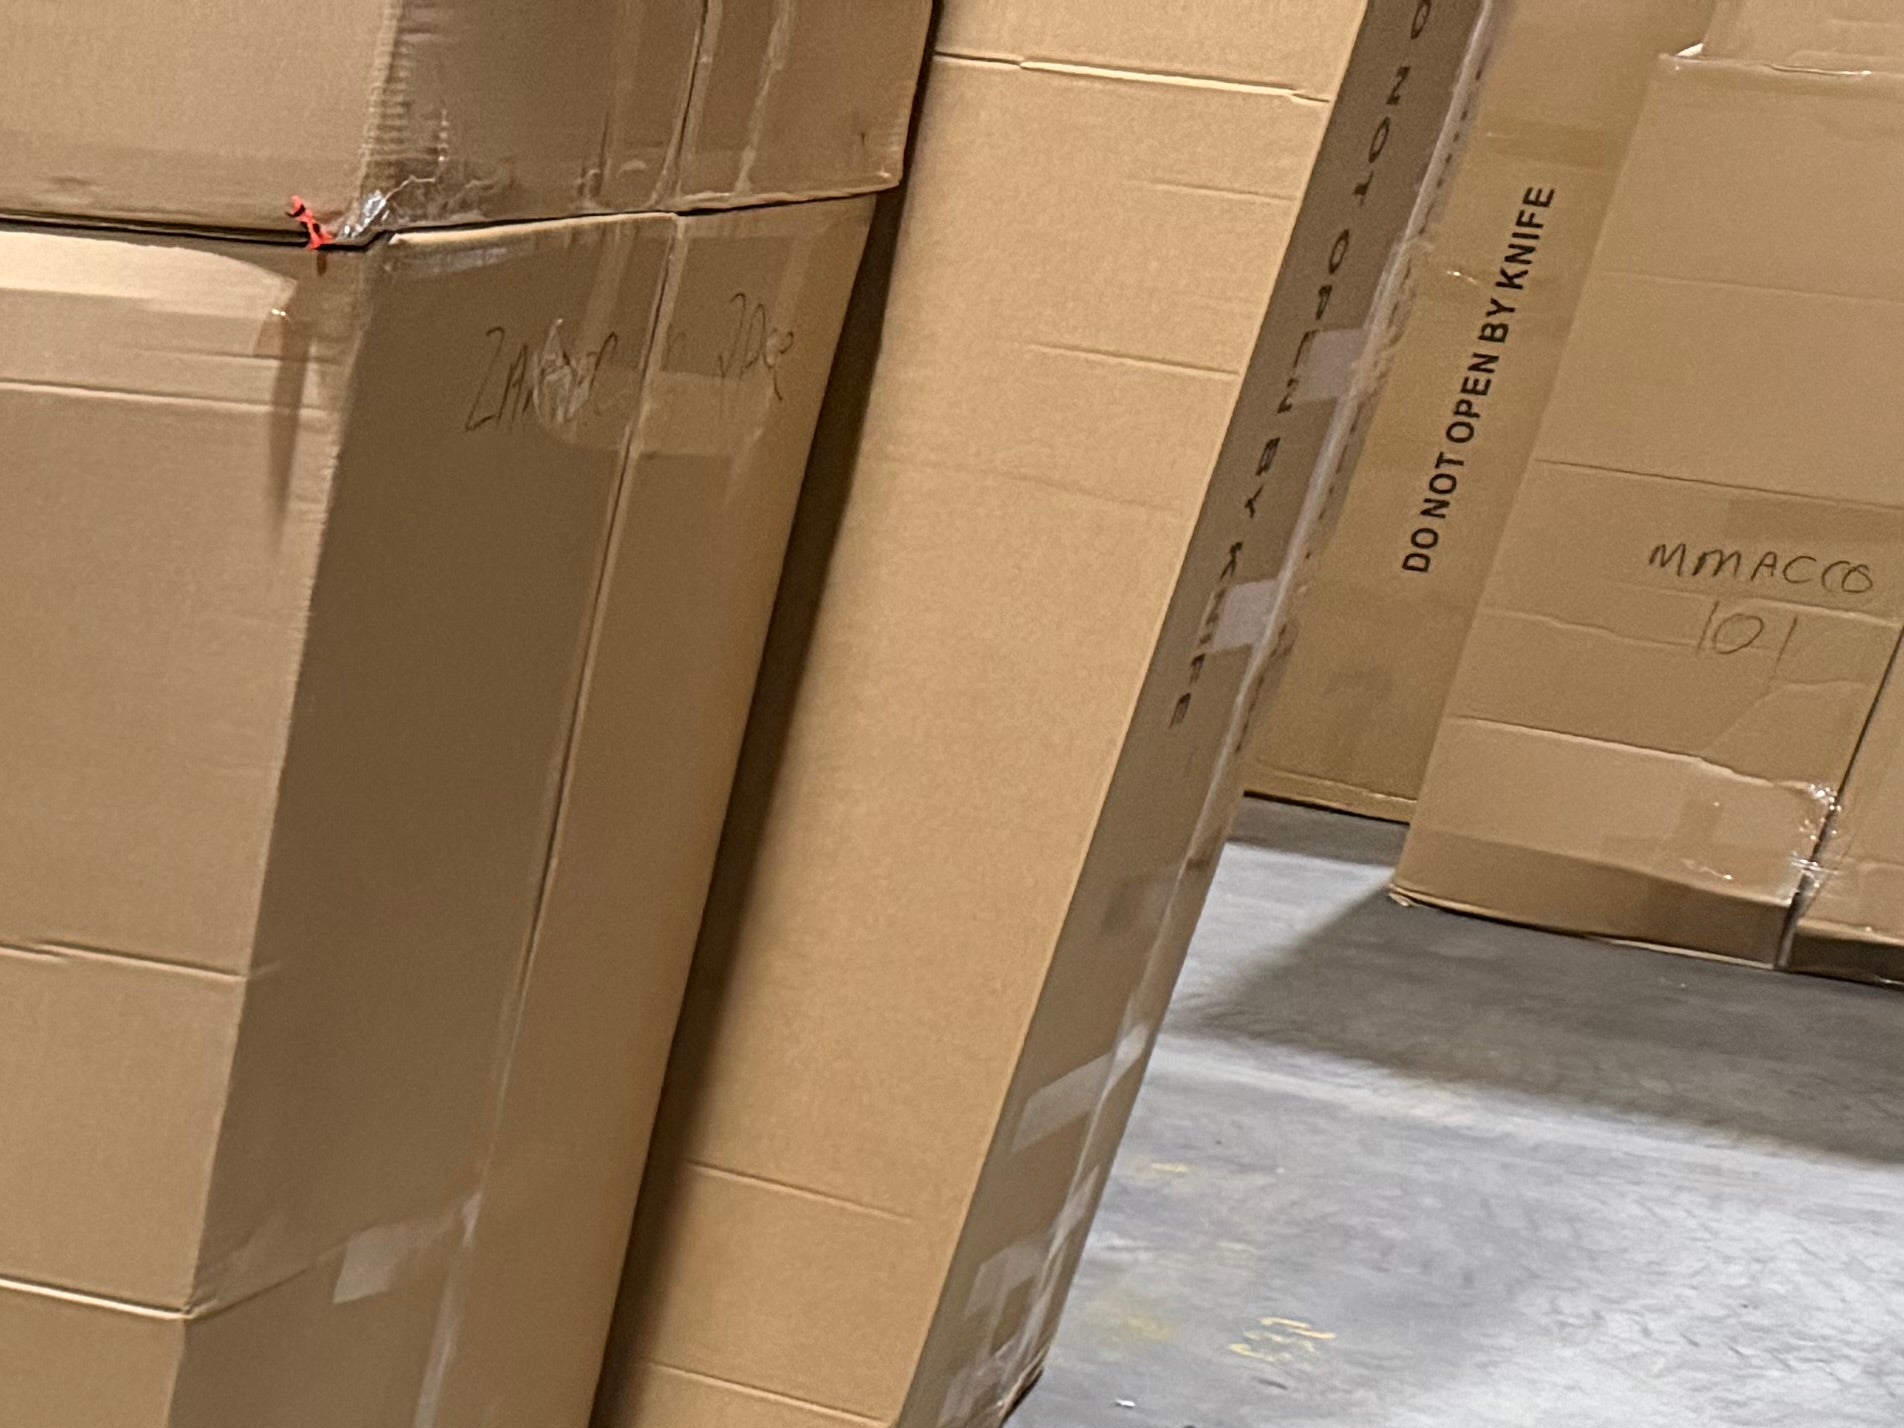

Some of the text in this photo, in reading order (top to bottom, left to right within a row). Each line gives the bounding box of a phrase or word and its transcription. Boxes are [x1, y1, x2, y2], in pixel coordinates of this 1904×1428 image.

[1402, 186, 1555, 574] DO NOT OPEN BY KNIFE
